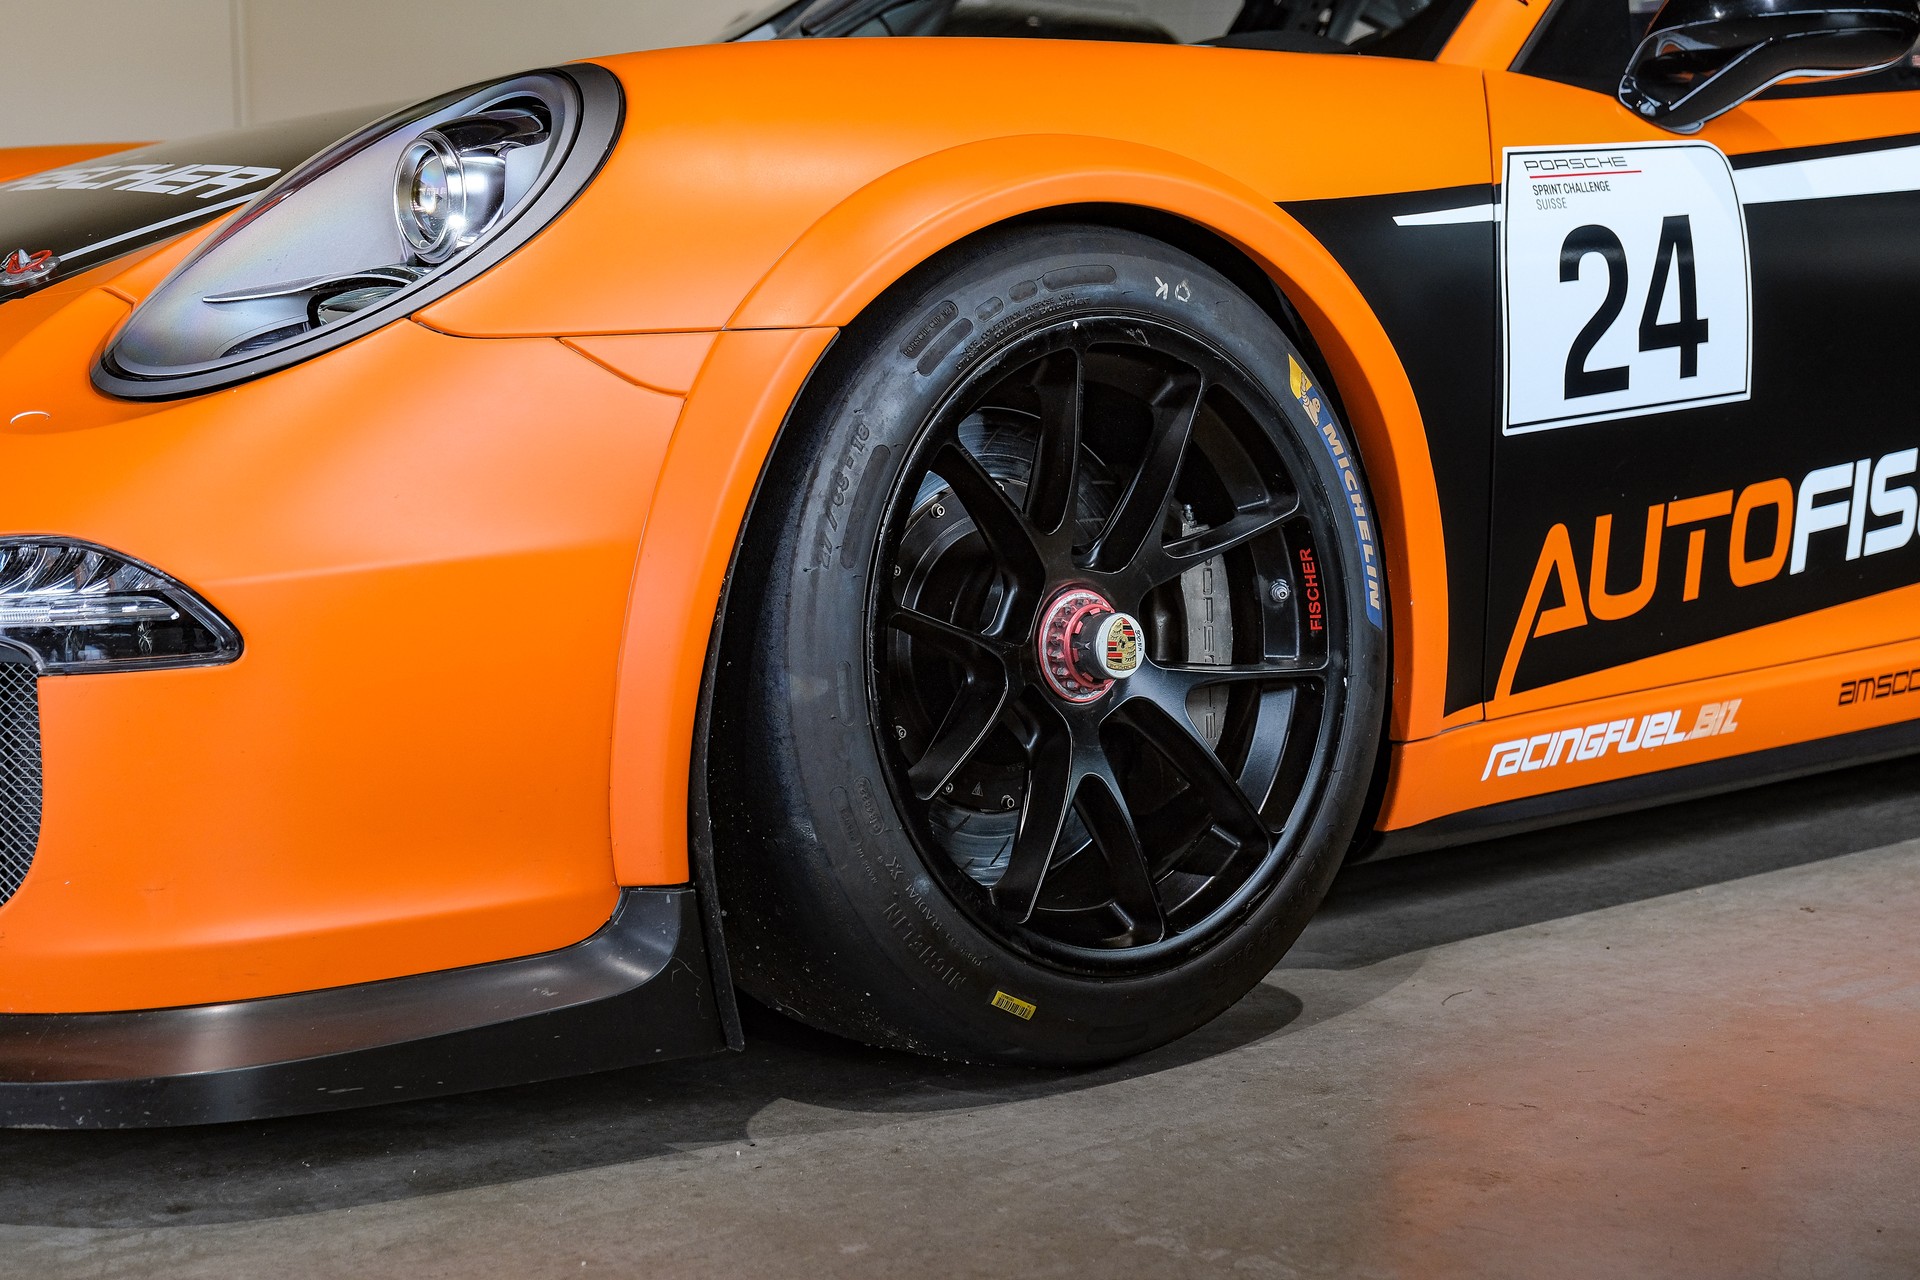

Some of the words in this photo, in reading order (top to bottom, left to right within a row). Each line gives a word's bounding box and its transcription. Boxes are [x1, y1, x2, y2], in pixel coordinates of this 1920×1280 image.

[1523, 156, 1628, 171] PORSCHE
[1532, 183, 1562, 196] SPRINT
[1563, 180, 1611, 194] CHALLENGE
[1536, 196, 1568, 210] SUISSE
[1559, 214, 1709, 401] 24
[1322, 423, 1381, 610] MICHELIN
[1300, 548, 1323, 632] FISCHER
[1493, 447, 1920, 702] AUTOFIS
